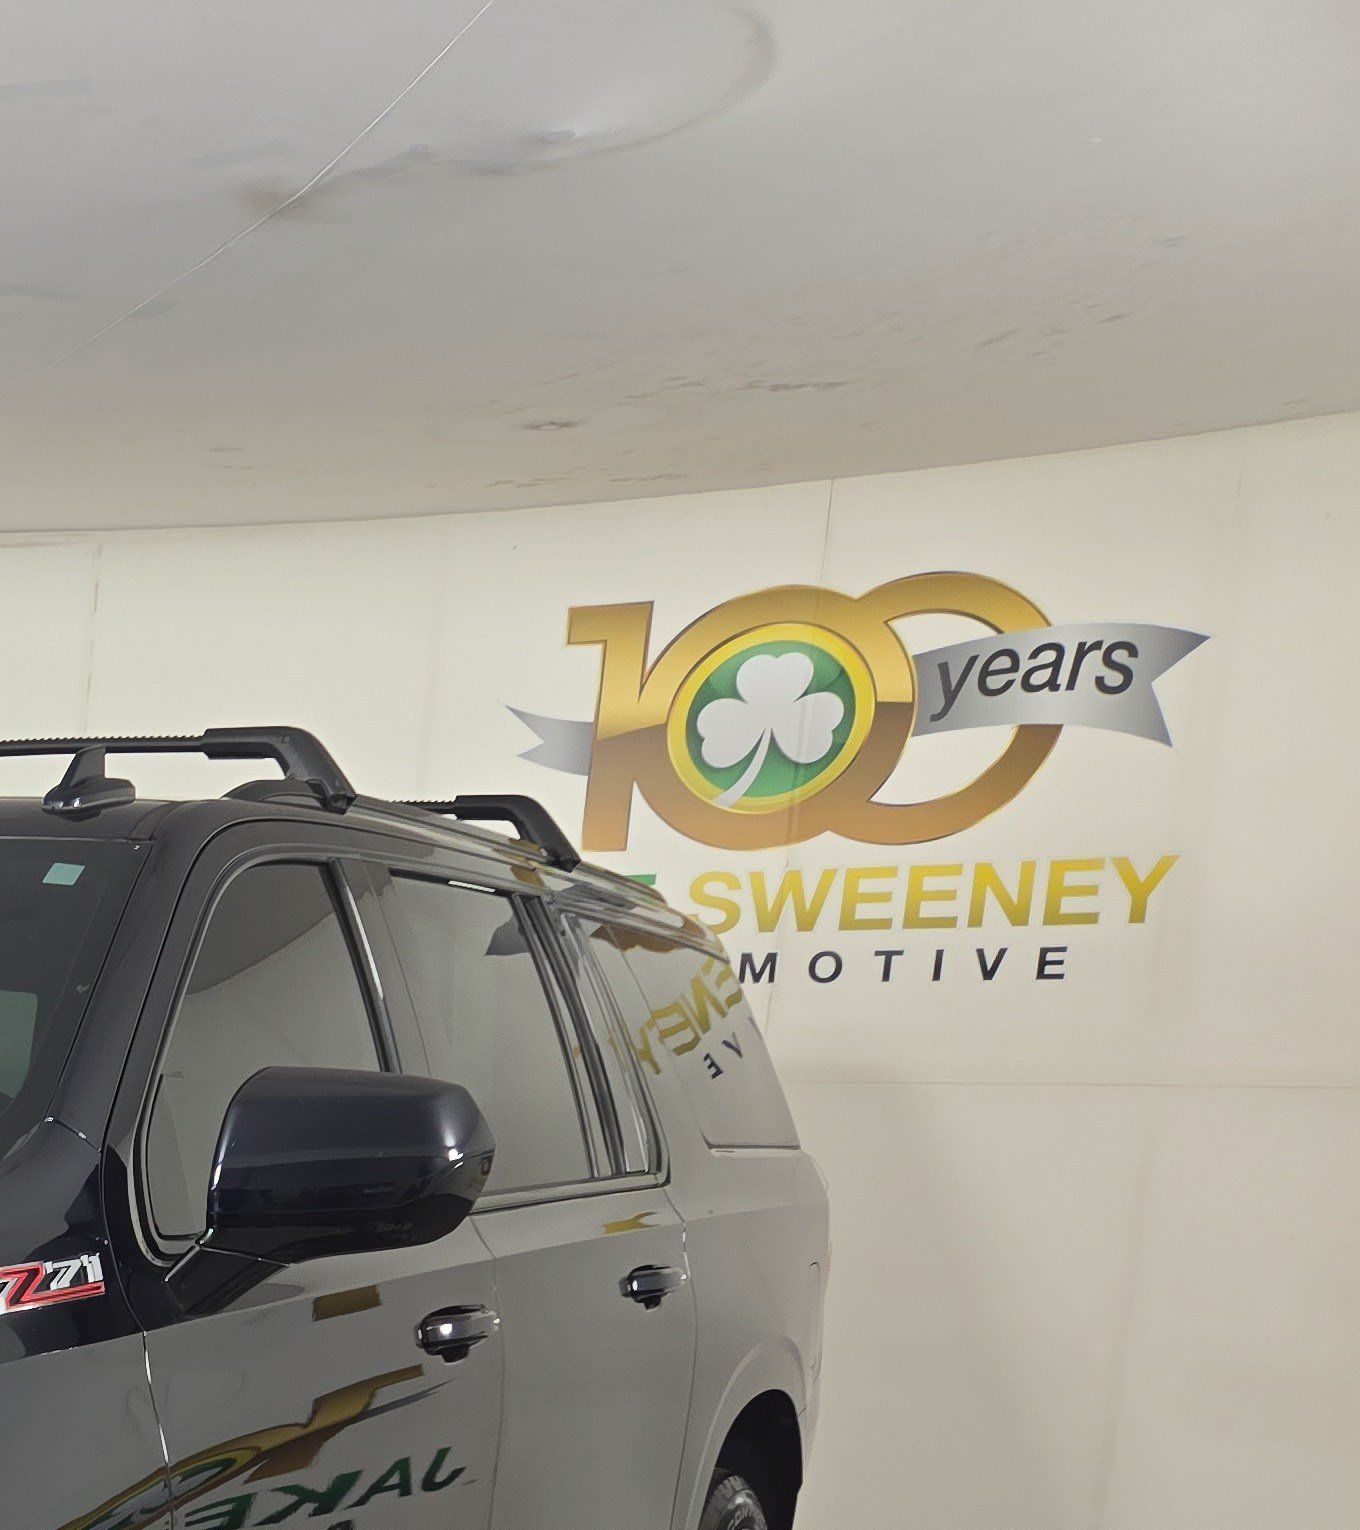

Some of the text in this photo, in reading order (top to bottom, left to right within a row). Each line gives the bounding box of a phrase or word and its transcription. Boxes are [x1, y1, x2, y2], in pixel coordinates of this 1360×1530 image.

[567, 571, 1064, 852] 100
[929, 641, 1139, 721] years
[689, 855, 1180, 935] SWEENEY
[739, 946, 1070, 984] MOTIVE
